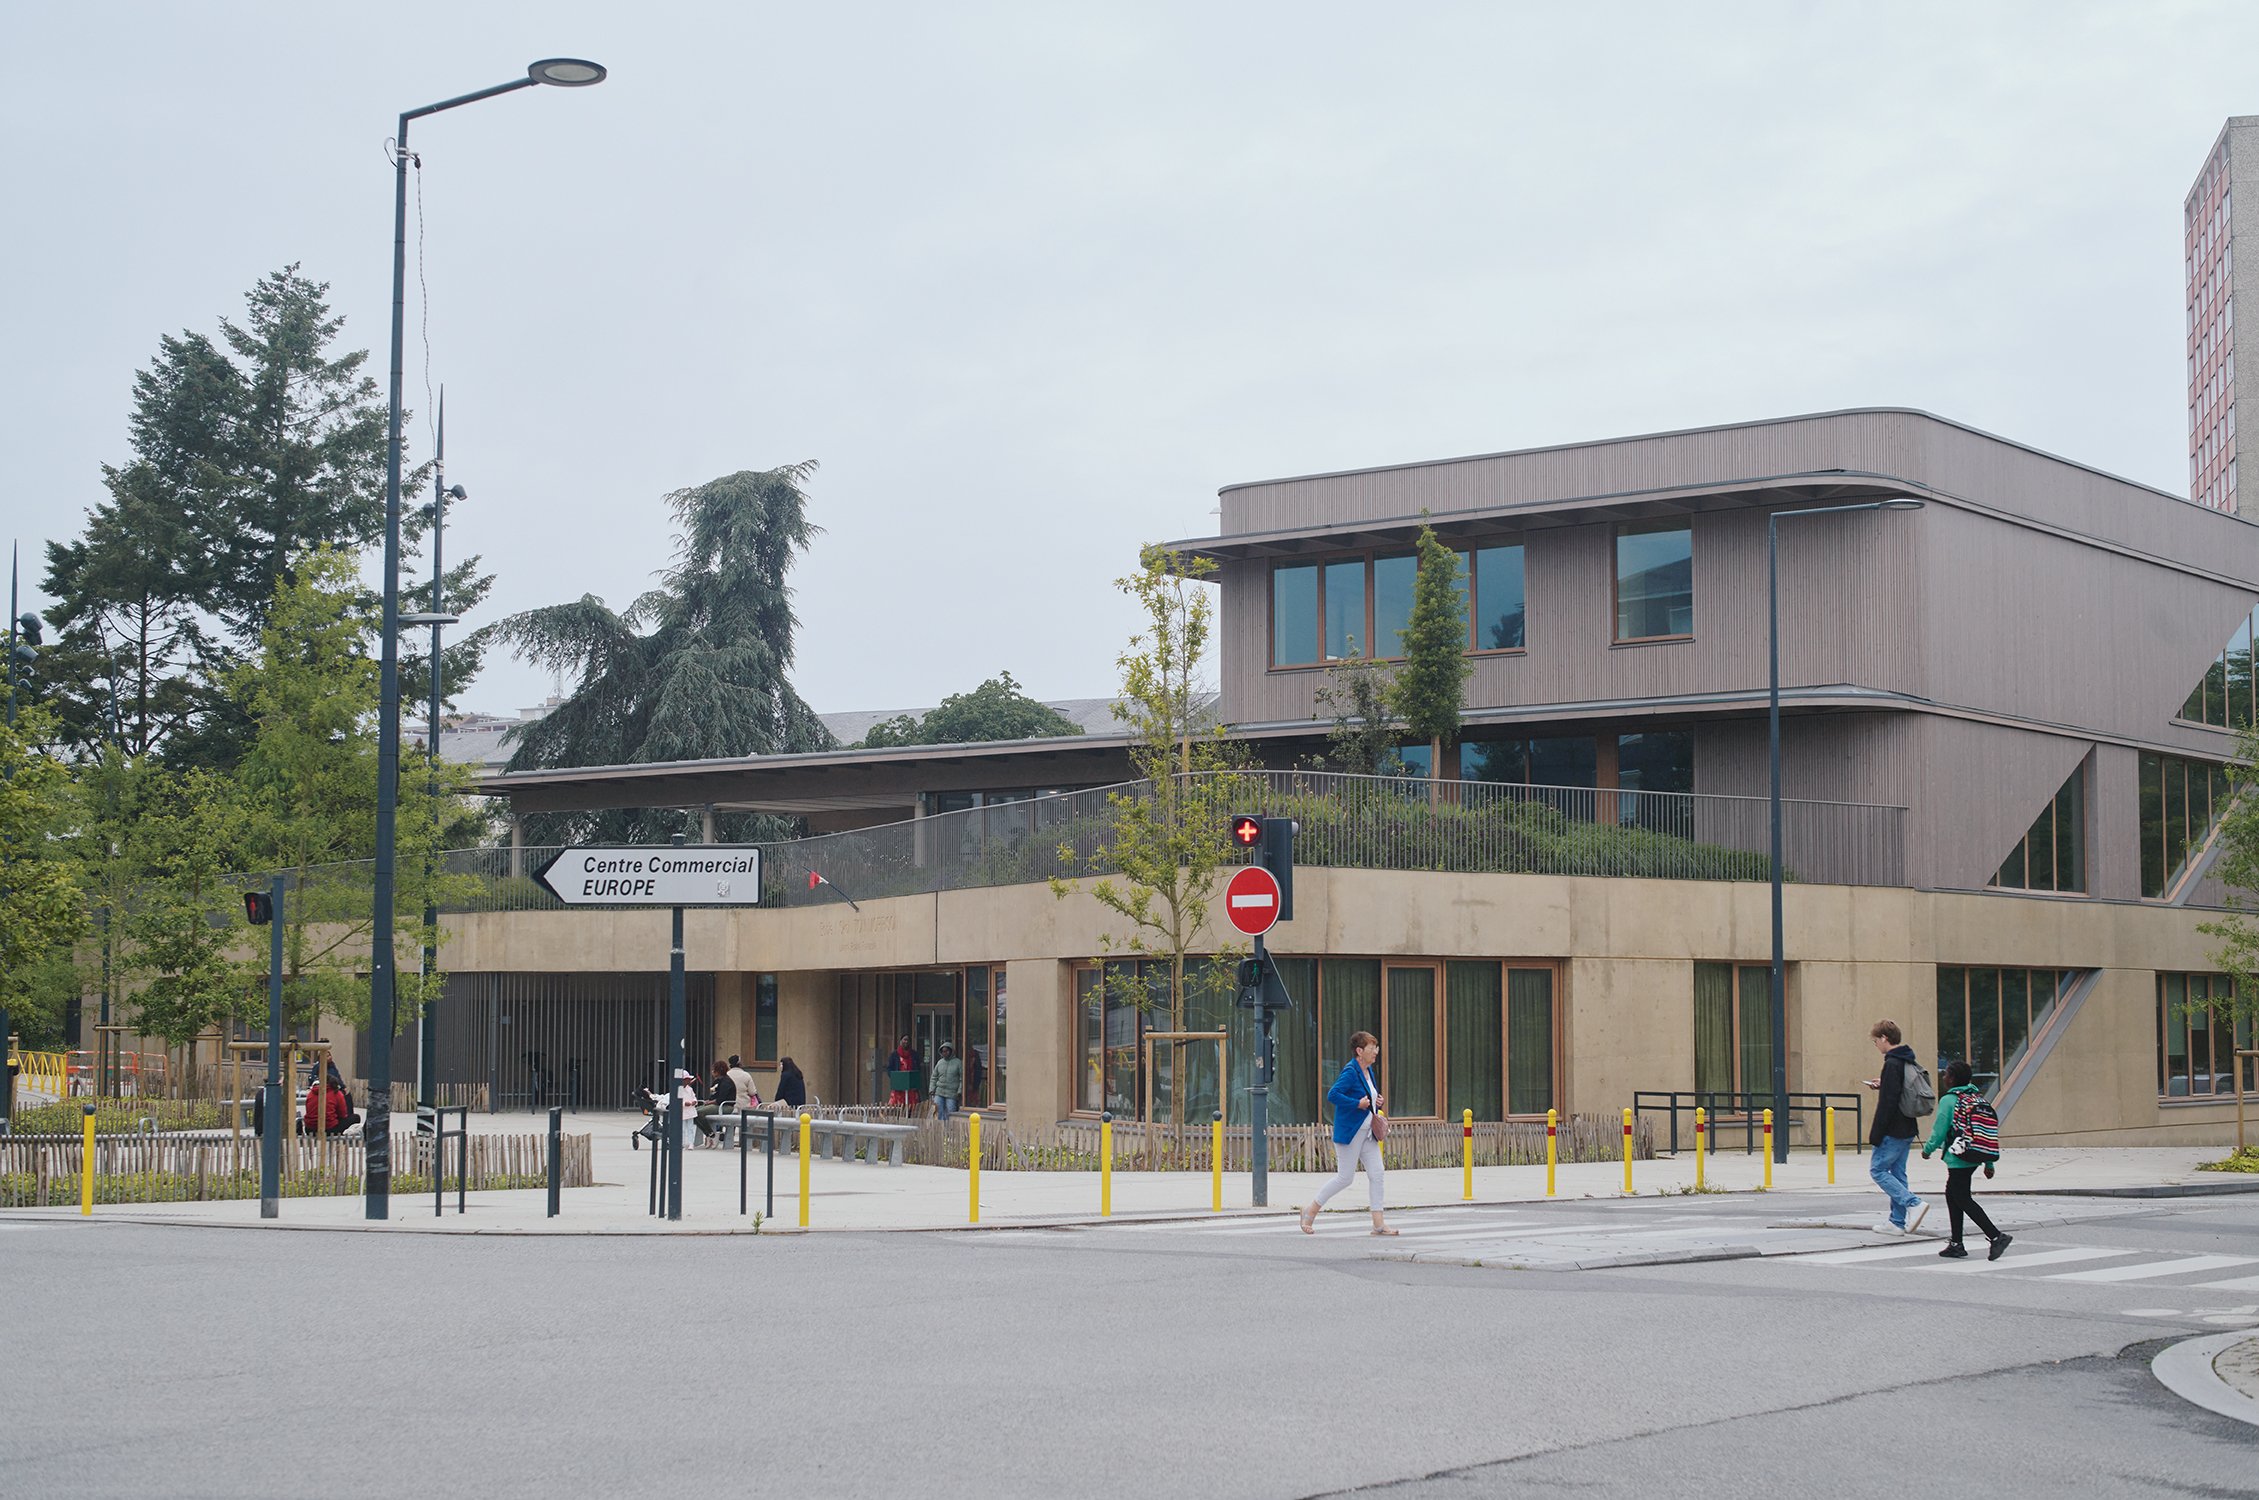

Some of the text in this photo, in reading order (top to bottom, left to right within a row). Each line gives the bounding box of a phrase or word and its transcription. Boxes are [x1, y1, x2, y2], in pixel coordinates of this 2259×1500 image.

[583, 856, 754, 873] Centre Commercial
[583, 879, 656, 896] EUROPE
